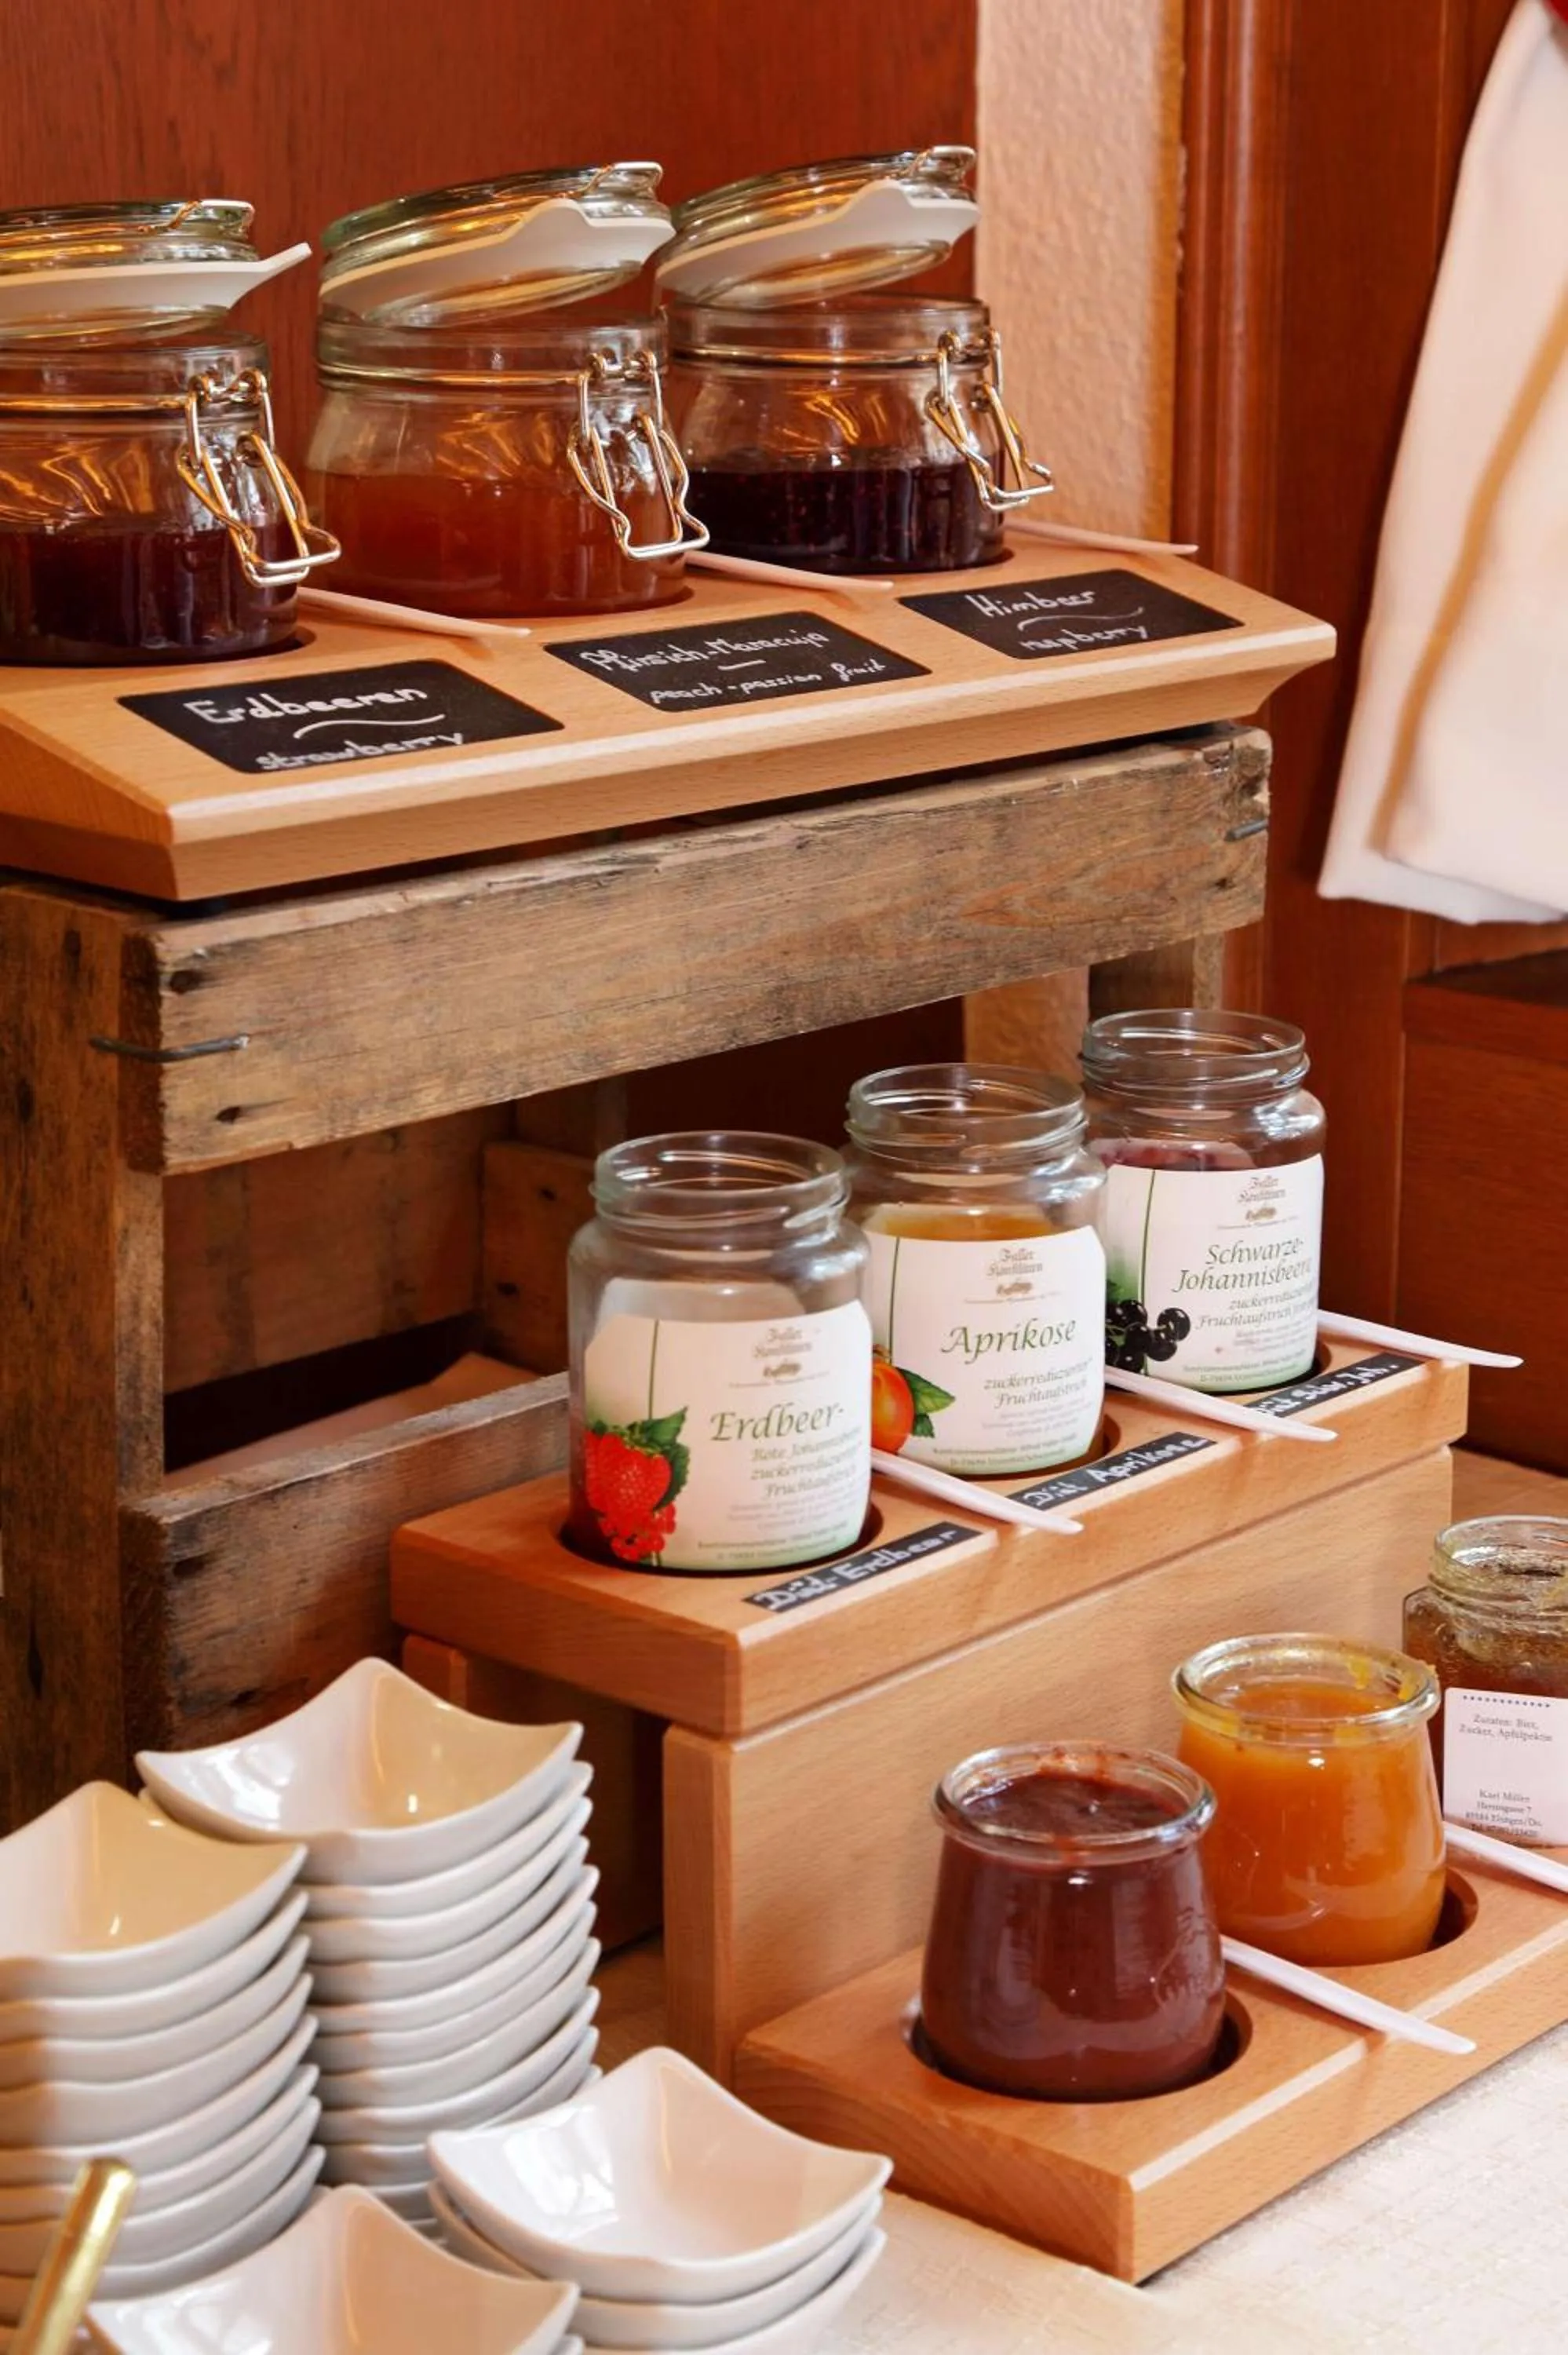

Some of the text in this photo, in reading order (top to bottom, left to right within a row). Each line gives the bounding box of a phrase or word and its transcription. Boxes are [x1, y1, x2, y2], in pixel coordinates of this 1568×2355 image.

[830, 659, 887, 682] fruit
[183, 688, 428, 724] Erdbeeren
[255, 731, 465, 772] strawberry
[1205, 1237, 1304, 1265] Schwarze-
[941, 1317, 1077, 1365] Aprikose
[709, 1402, 845, 1443] Erdbeer-
[1086, 1437, 1208, 1483] Aprikose
